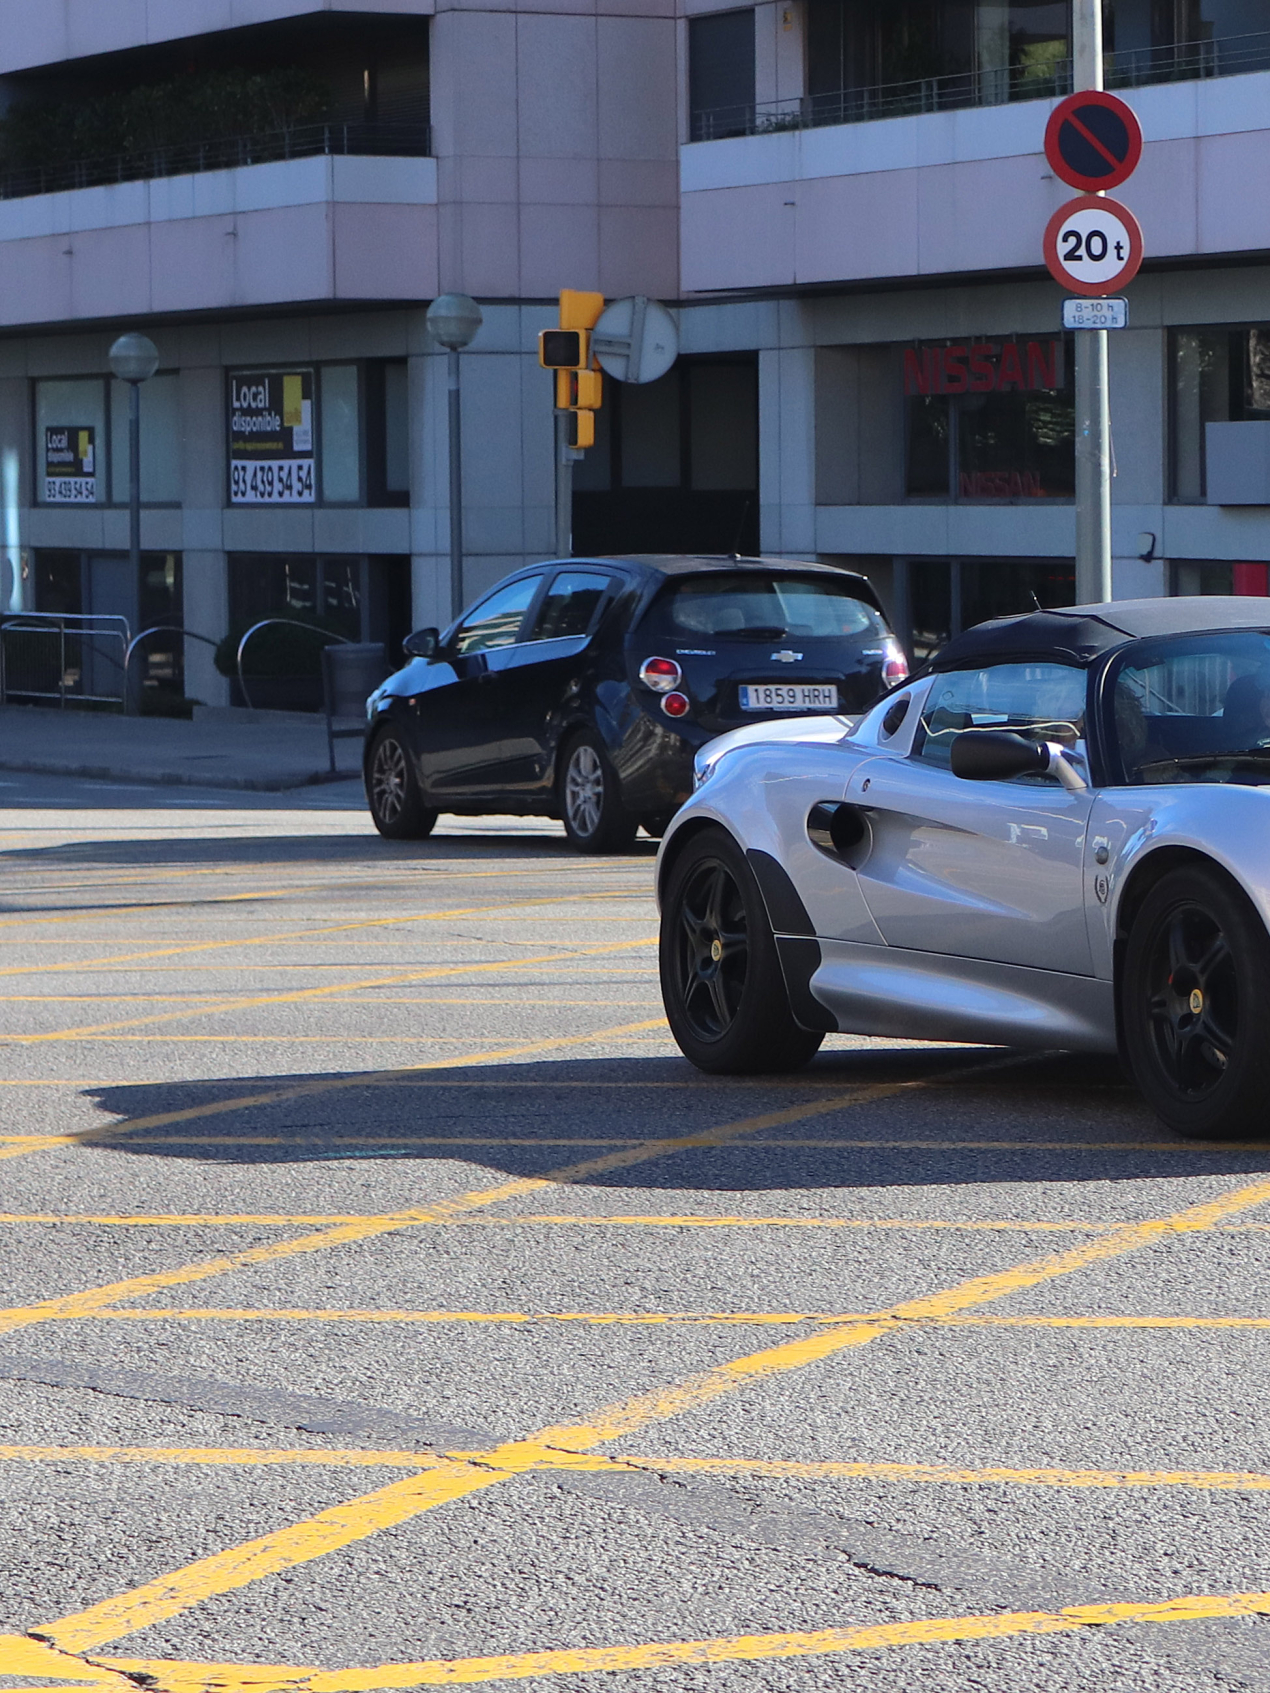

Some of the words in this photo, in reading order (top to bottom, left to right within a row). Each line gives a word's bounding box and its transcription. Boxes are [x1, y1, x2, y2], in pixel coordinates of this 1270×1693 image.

[1061, 229, 1108, 262] 20
[1114, 240, 1125, 261] t
[1071, 315, 1108, 325] 18-20
[1111, 315, 1118, 325] h
[1075, 303, 1103, 313] 8-10
[1107, 303, 1114, 313] h
[904, 341, 1057, 395] NISSAN
[232, 378, 269, 409] Local
[232, 411, 281, 436] disponible
[47, 429, 69, 449] Local
[232, 464, 248, 498] 93
[250, 464, 275, 499] 439
[277, 464, 293, 498] 54
[296, 463, 313, 498] 54
[753, 687, 797, 705] 1859
[801, 687, 833, 705] HRH
